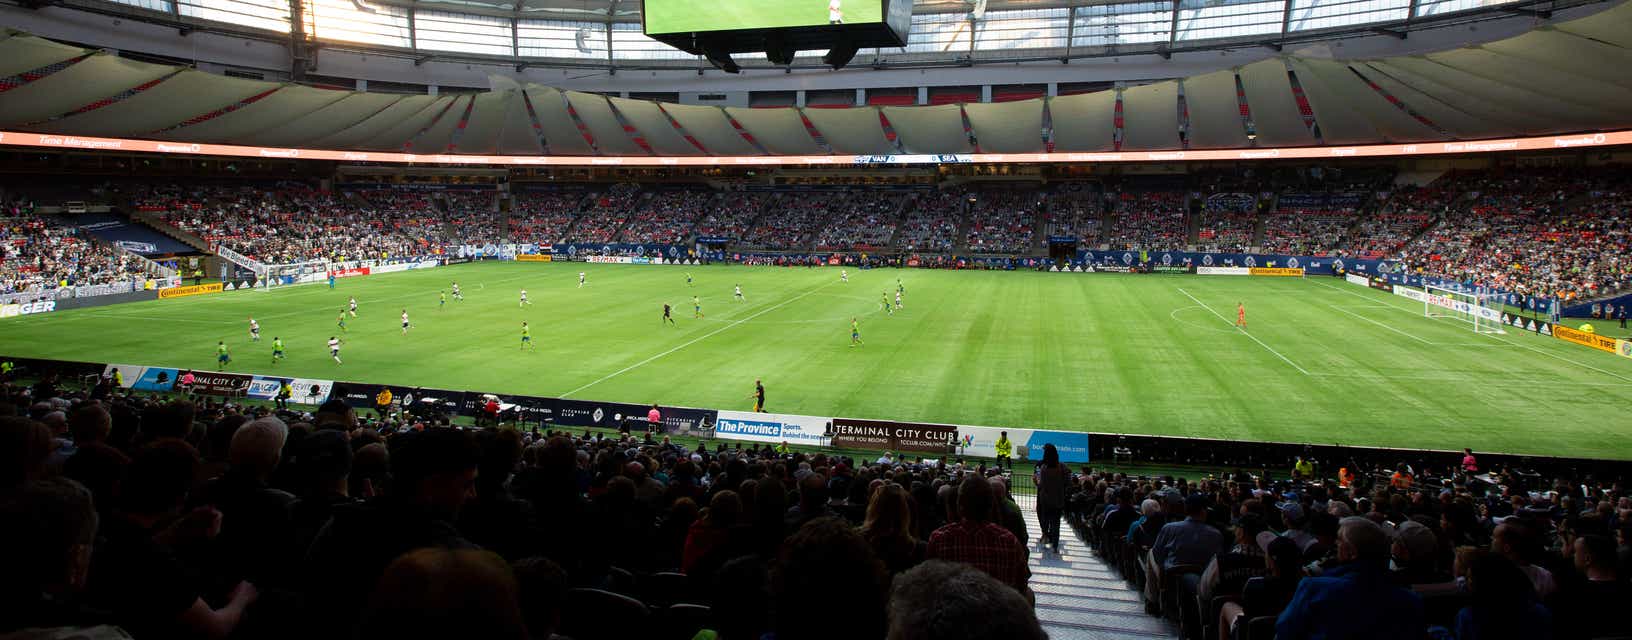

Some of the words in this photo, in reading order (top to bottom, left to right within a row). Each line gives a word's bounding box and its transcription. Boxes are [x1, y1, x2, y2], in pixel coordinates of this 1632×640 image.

[39, 135, 62, 145] Time
[942, 154, 956, 162] SEA
[1599, 339, 1616, 351] TIRE
[212, 377, 229, 387] CITY
[719, 420, 737, 433] The
[737, 422, 779, 437] Province
[836, 425, 890, 438] TERMINAL
[896, 428, 921, 439] CITY
[925, 430, 954, 440] CLUB
